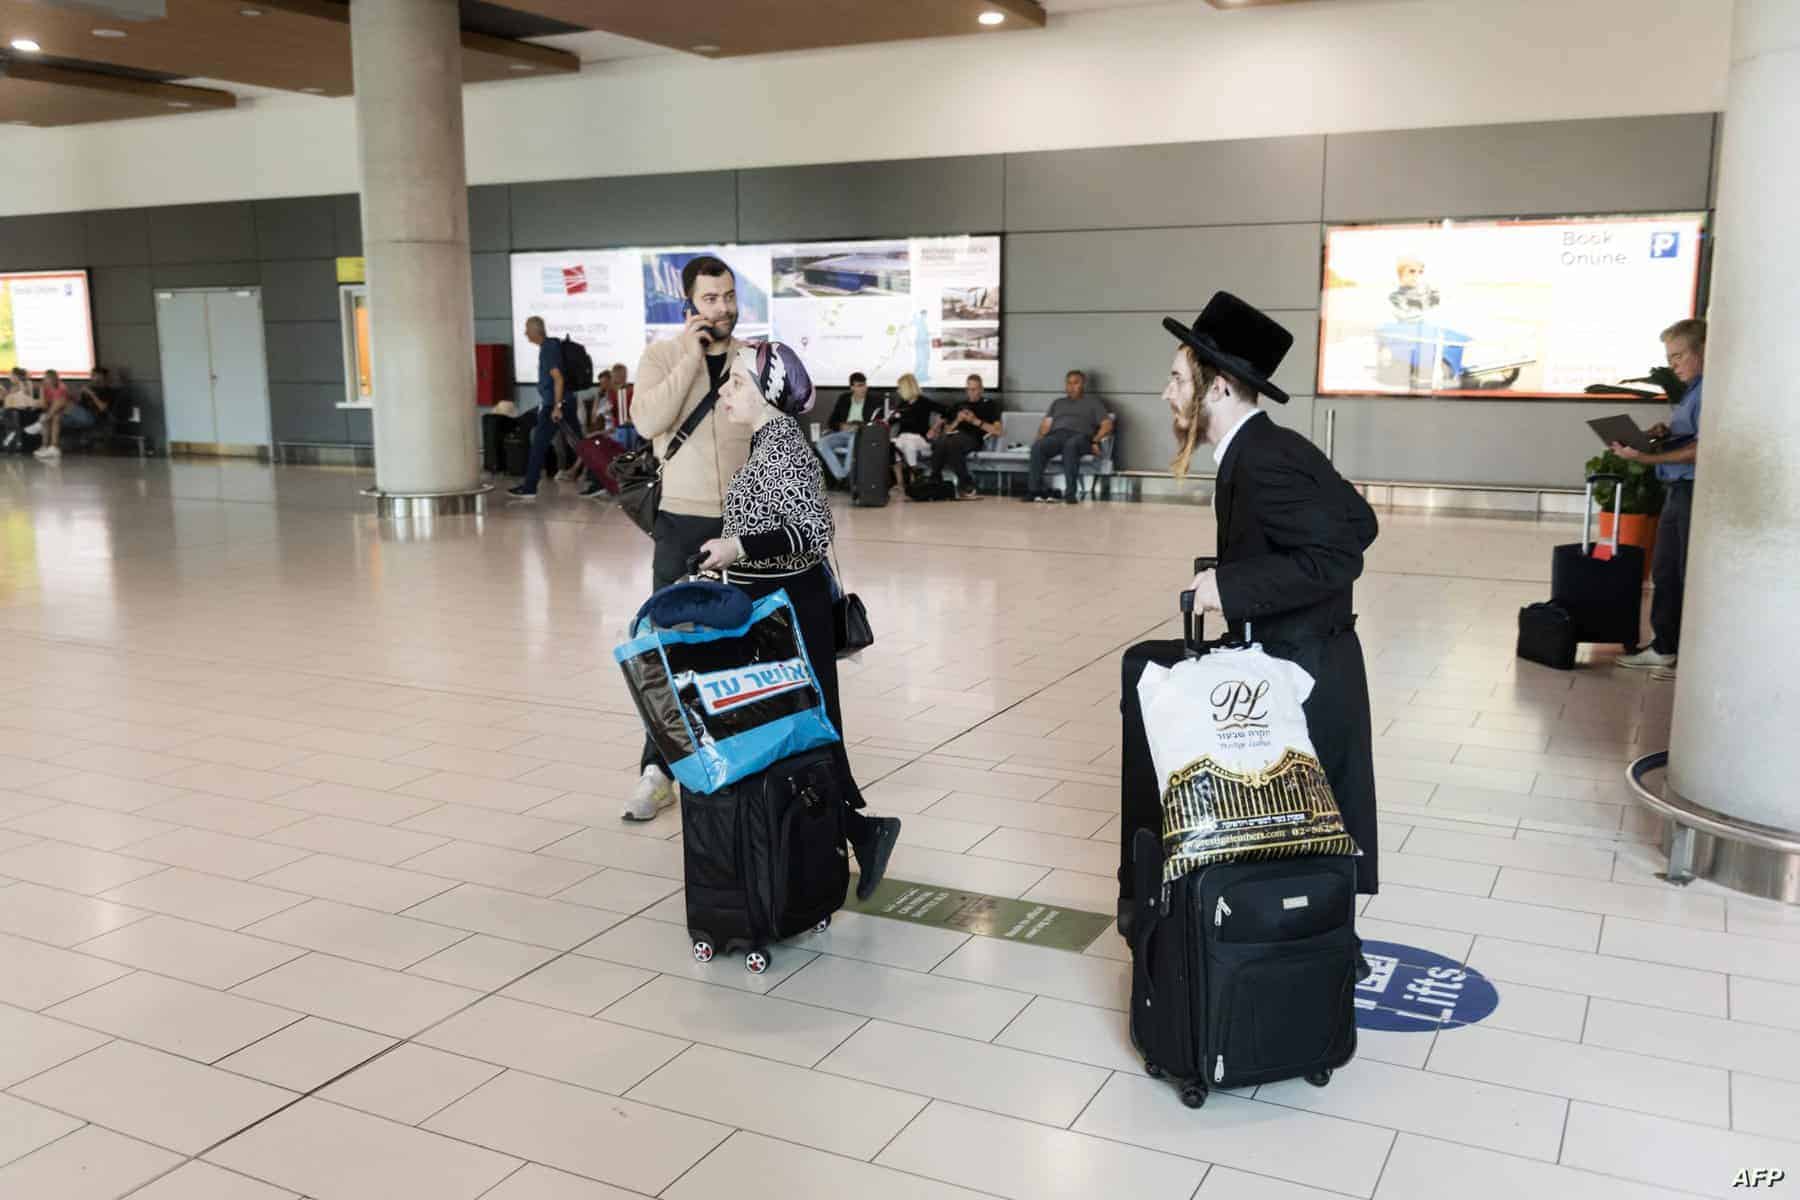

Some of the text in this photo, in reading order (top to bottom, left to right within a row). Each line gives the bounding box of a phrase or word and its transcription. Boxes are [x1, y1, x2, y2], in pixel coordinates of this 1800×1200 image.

[1562, 230, 1614, 246] Book
[1560, 251, 1627, 266] Online
[703, 663, 805, 698] אושר עד
[1209, 679, 1270, 722] PL
[1395, 966, 1467, 1023] Lifts
